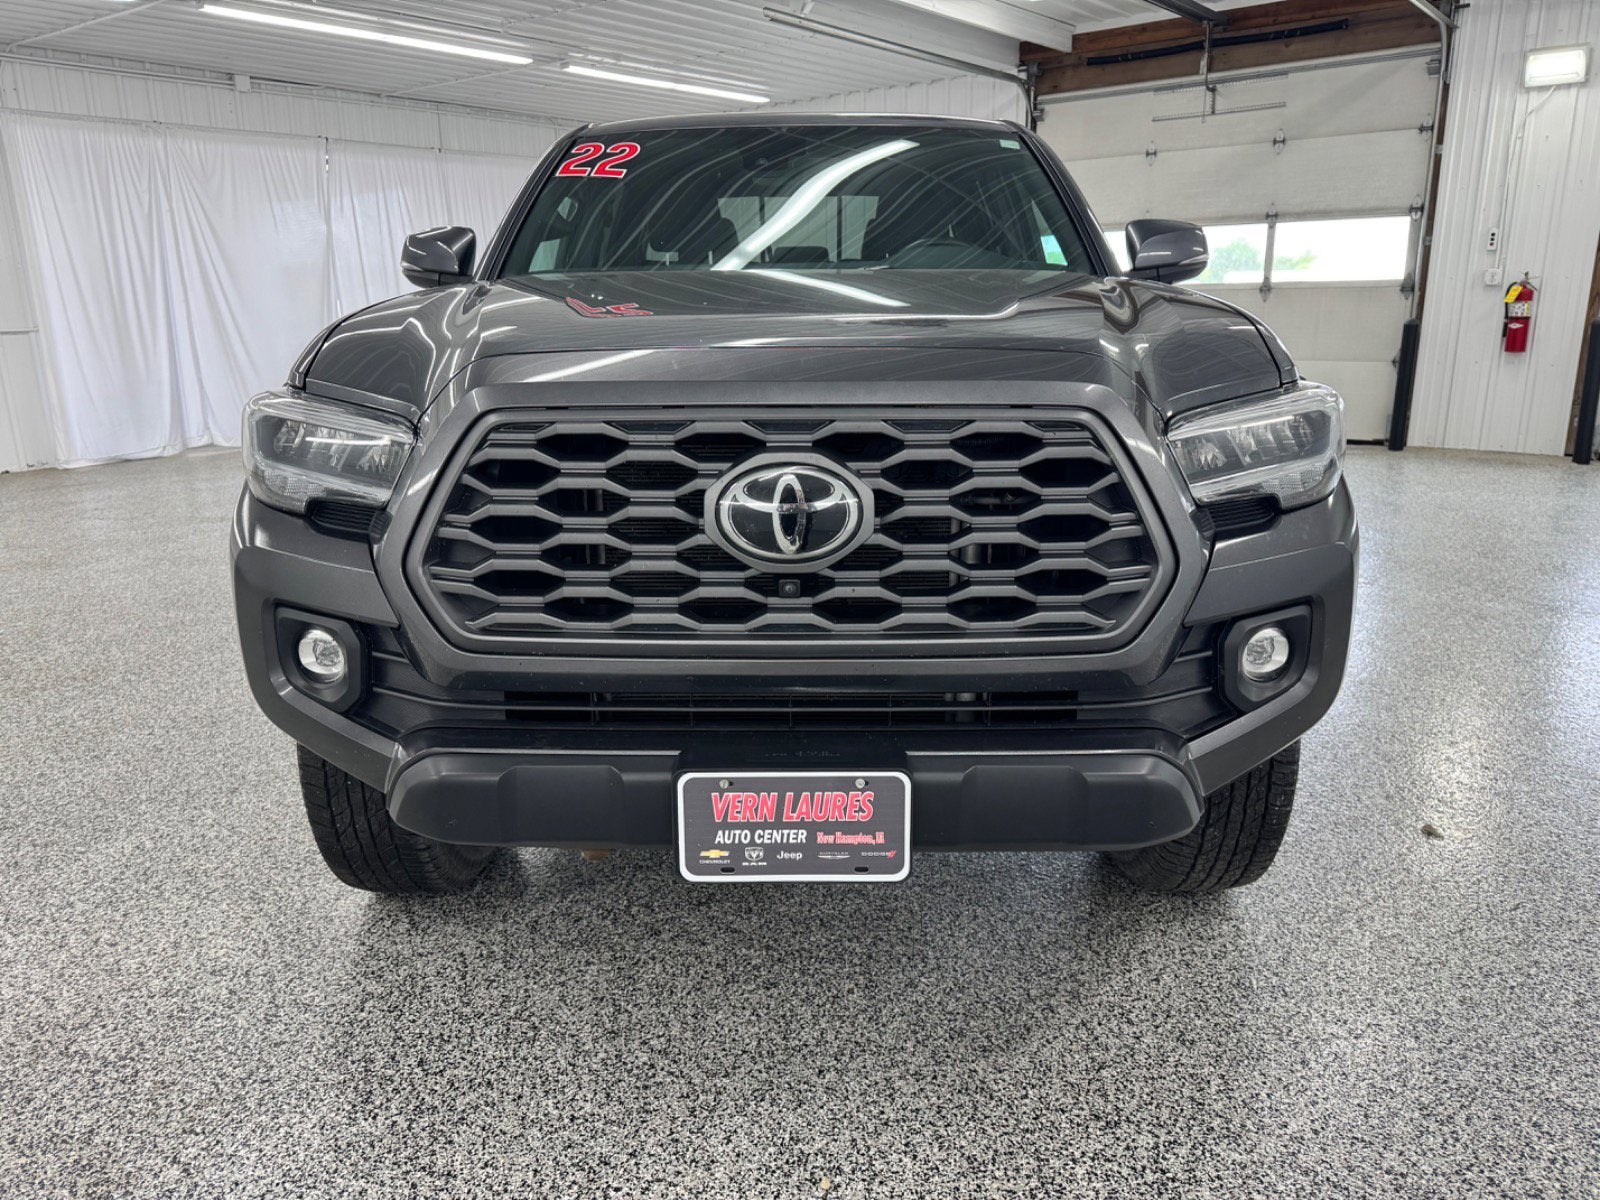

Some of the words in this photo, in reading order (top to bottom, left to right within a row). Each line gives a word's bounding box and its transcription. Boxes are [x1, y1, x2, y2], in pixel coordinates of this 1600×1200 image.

[555, 141, 641, 179] 22
[711, 792, 778, 822] VERN
[782, 791, 875, 822] LAURES
[714, 829, 751, 844] AUTO
[754, 829, 807, 844] CENTER
[816, 831, 835, 844] New
[776, 850, 803, 860] Jeep
